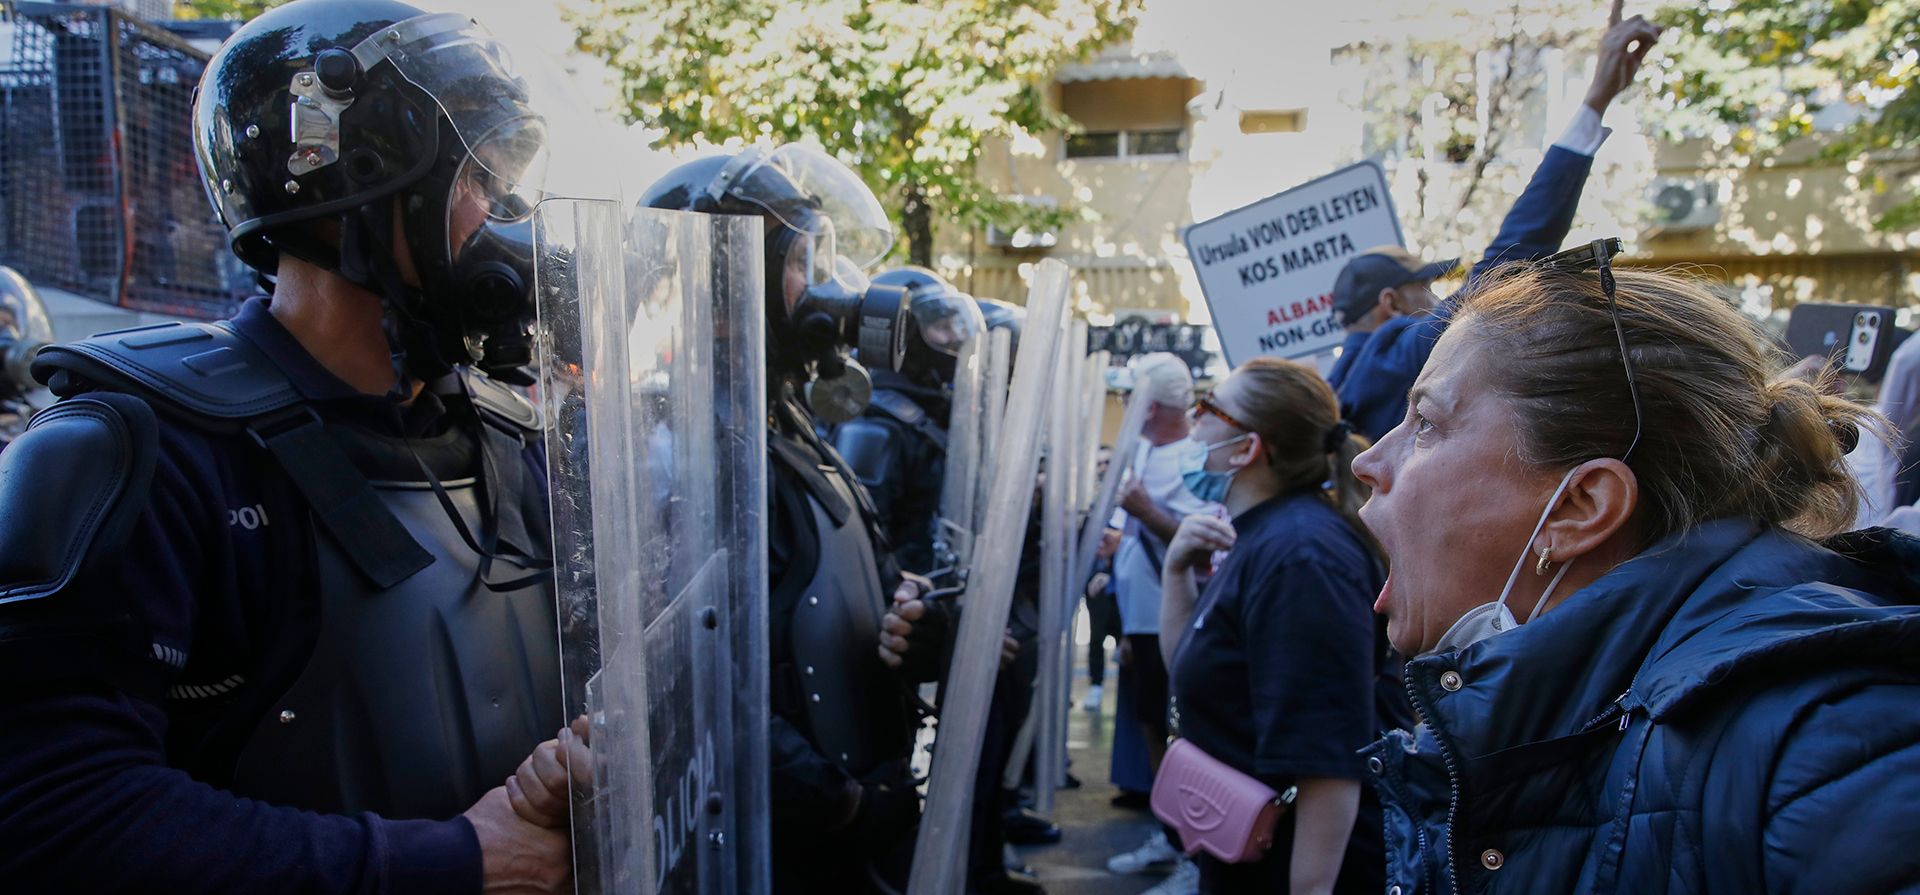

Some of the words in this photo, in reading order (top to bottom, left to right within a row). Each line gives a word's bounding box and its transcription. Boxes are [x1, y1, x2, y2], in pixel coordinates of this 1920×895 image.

[1199, 233, 1249, 266] Ursula
[1247, 216, 1287, 249] VON
[1287, 204, 1323, 238] DER
[1322, 185, 1379, 223] LEYEN
[1238, 257, 1279, 288] KOS
[1282, 233, 1355, 274] MARTA
[1259, 316, 1342, 353] NON-GR
[1267, 293, 1334, 327] ALBAN
[653, 730, 717, 895] OLICIA
